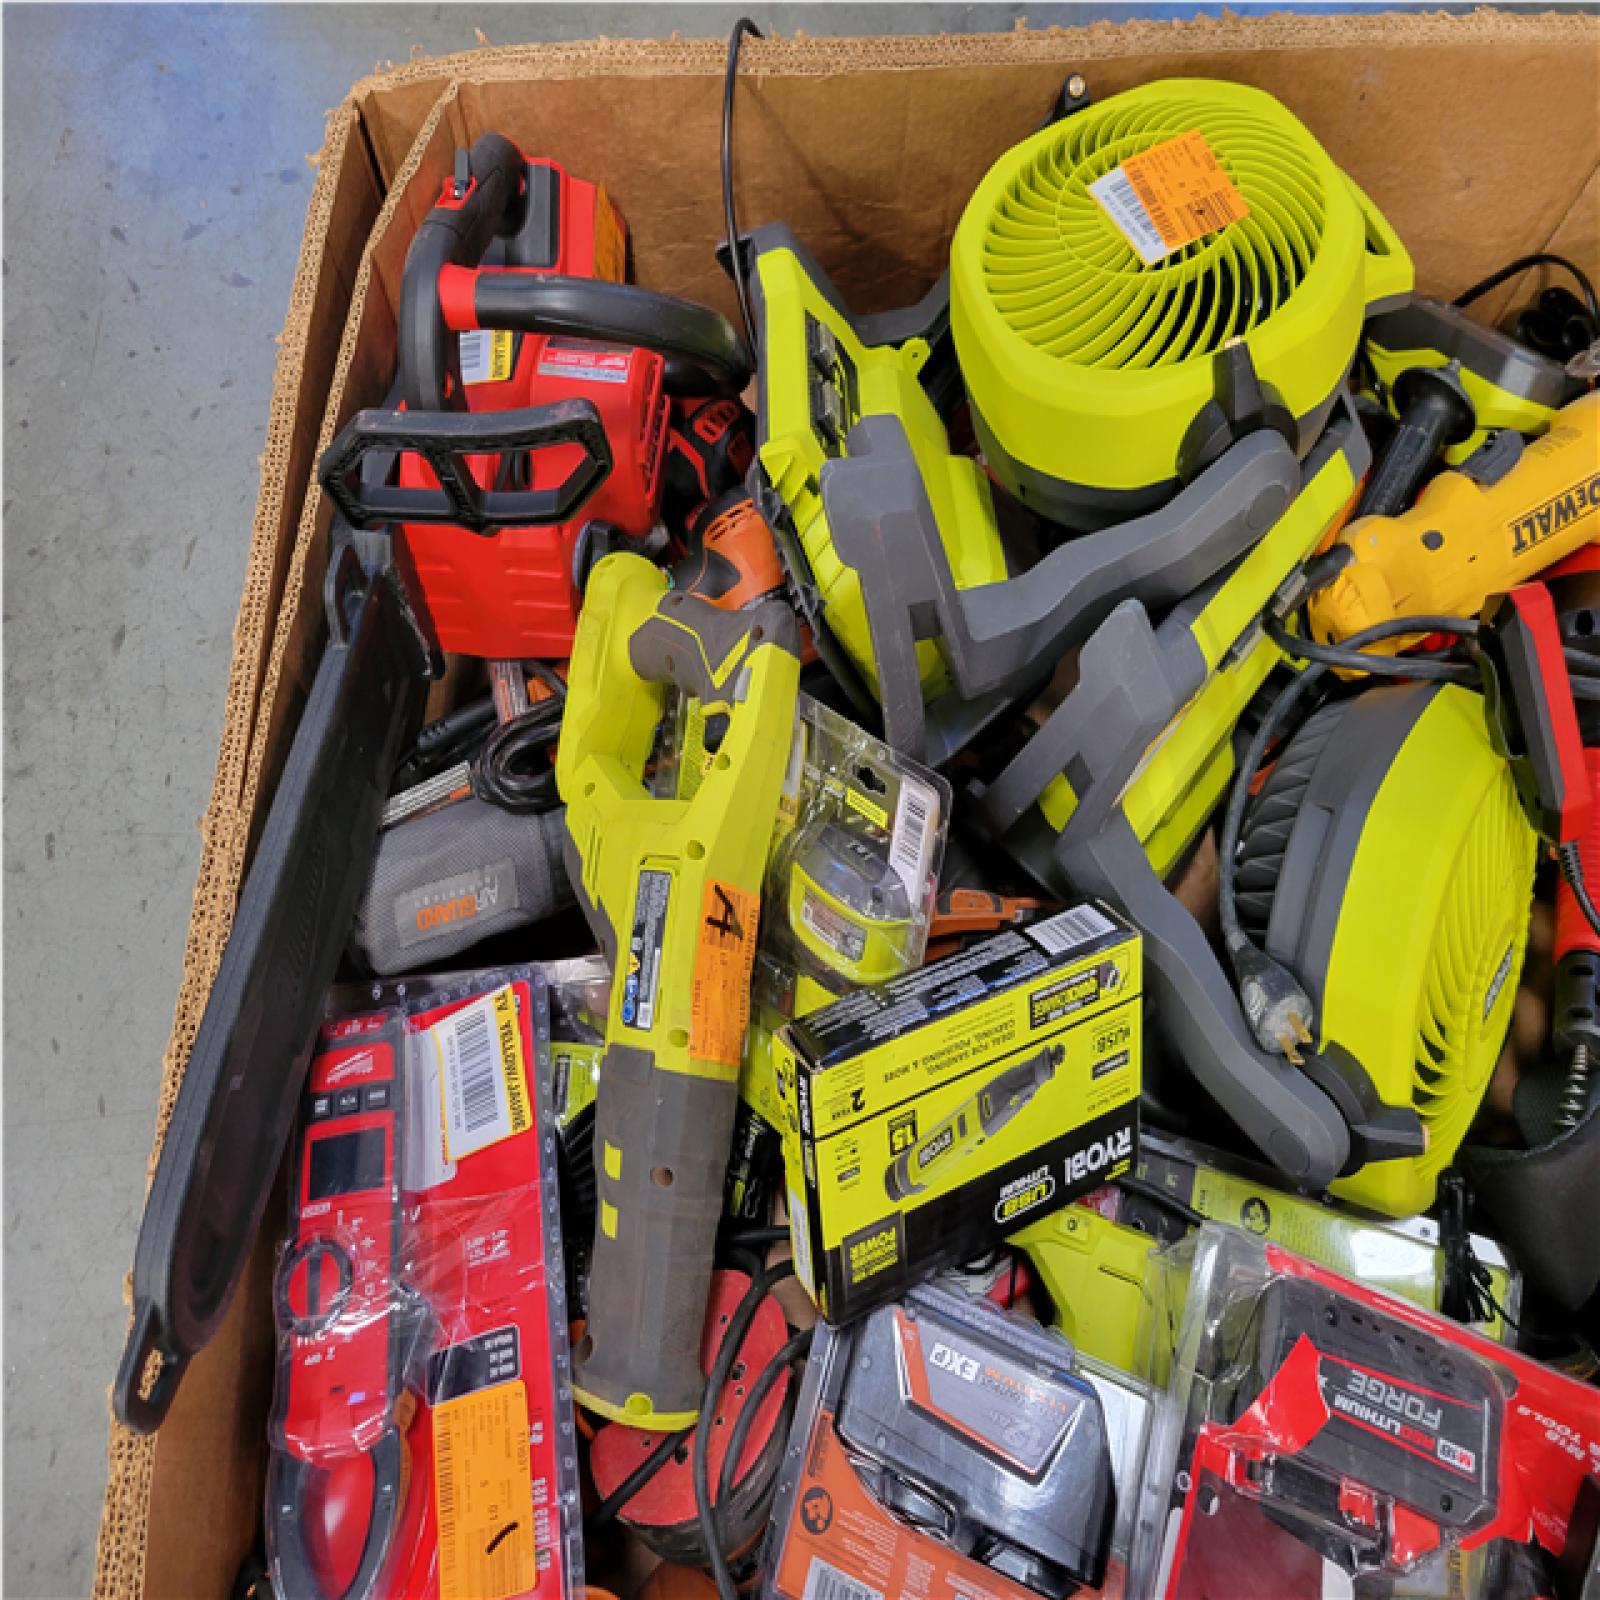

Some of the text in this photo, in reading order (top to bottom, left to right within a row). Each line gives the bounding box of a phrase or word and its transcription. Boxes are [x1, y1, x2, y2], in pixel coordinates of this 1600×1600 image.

[852, 1088, 866, 1112] 2
[1065, 1127, 1133, 1185] RYOBI
[1347, 1370, 1442, 1431] FORGE
